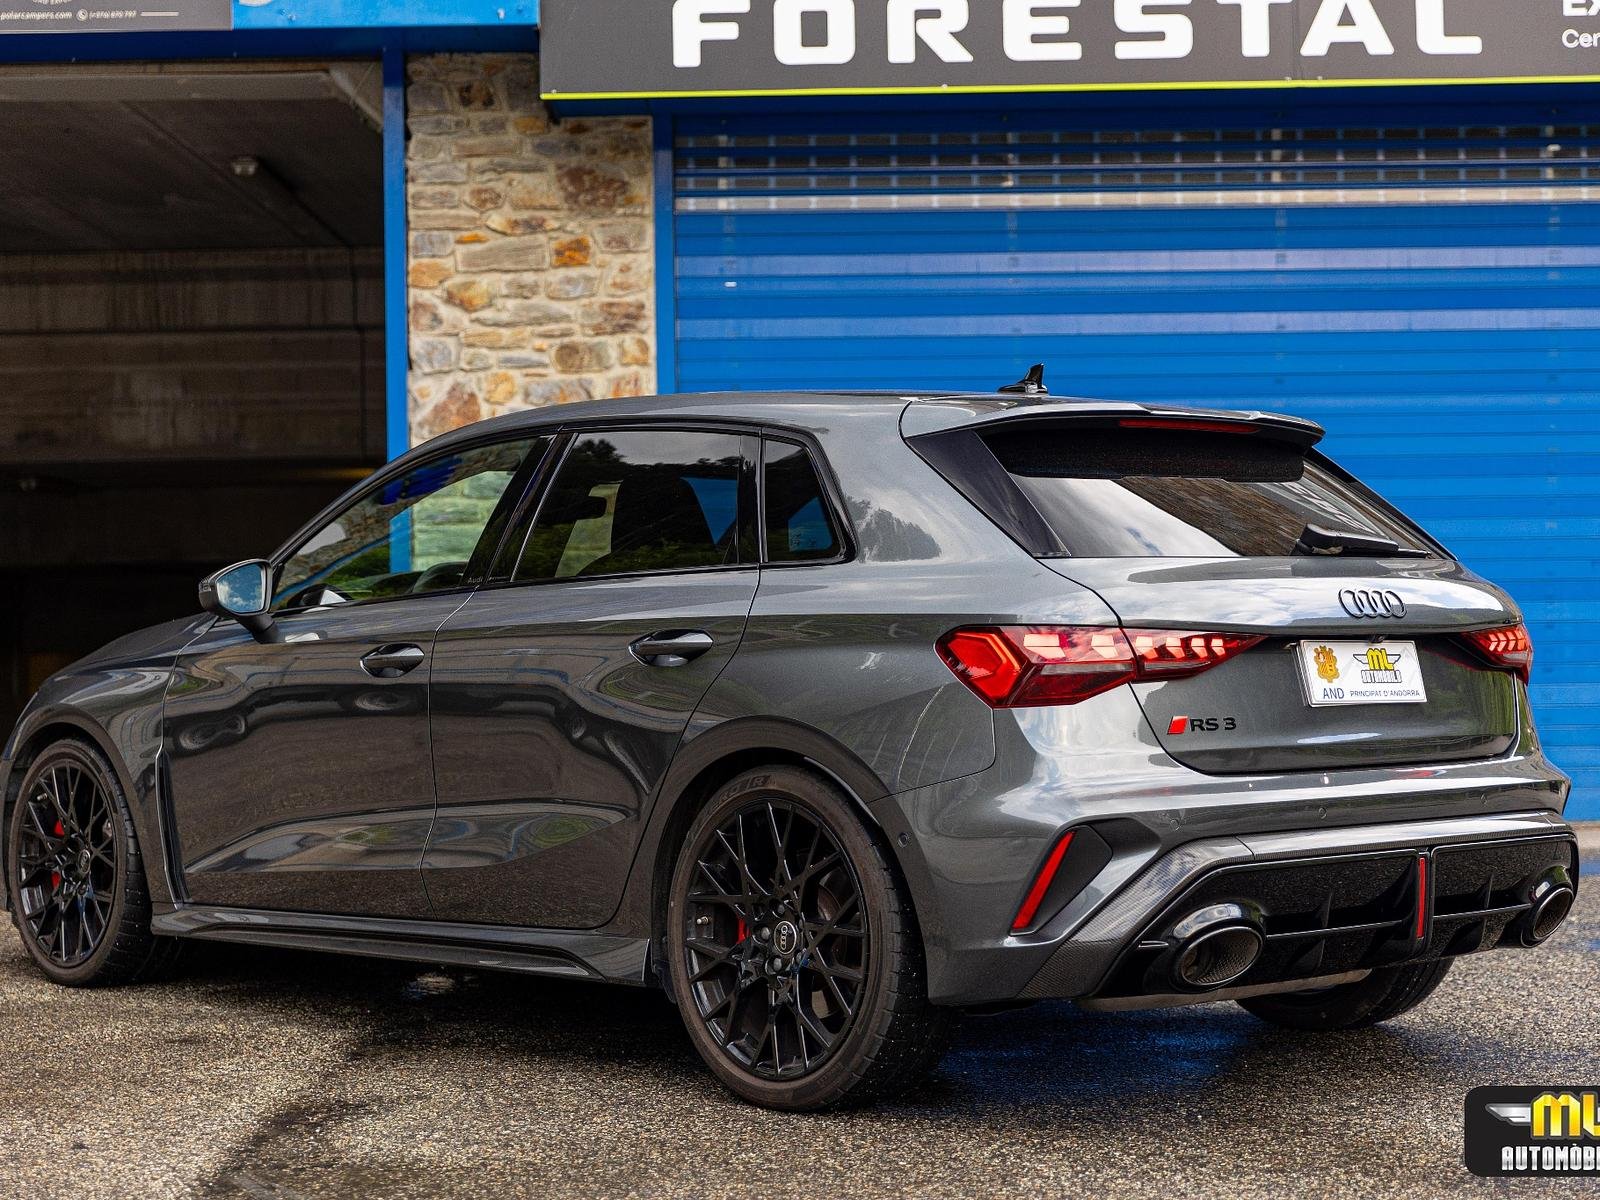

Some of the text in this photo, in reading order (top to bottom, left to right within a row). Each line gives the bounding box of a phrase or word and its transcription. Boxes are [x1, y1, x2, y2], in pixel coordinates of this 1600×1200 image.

[673, 0, 1482, 68] FORESTAL
[1323, 687, 1345, 699] AND
[1189, 717, 1237, 731] RS 3
